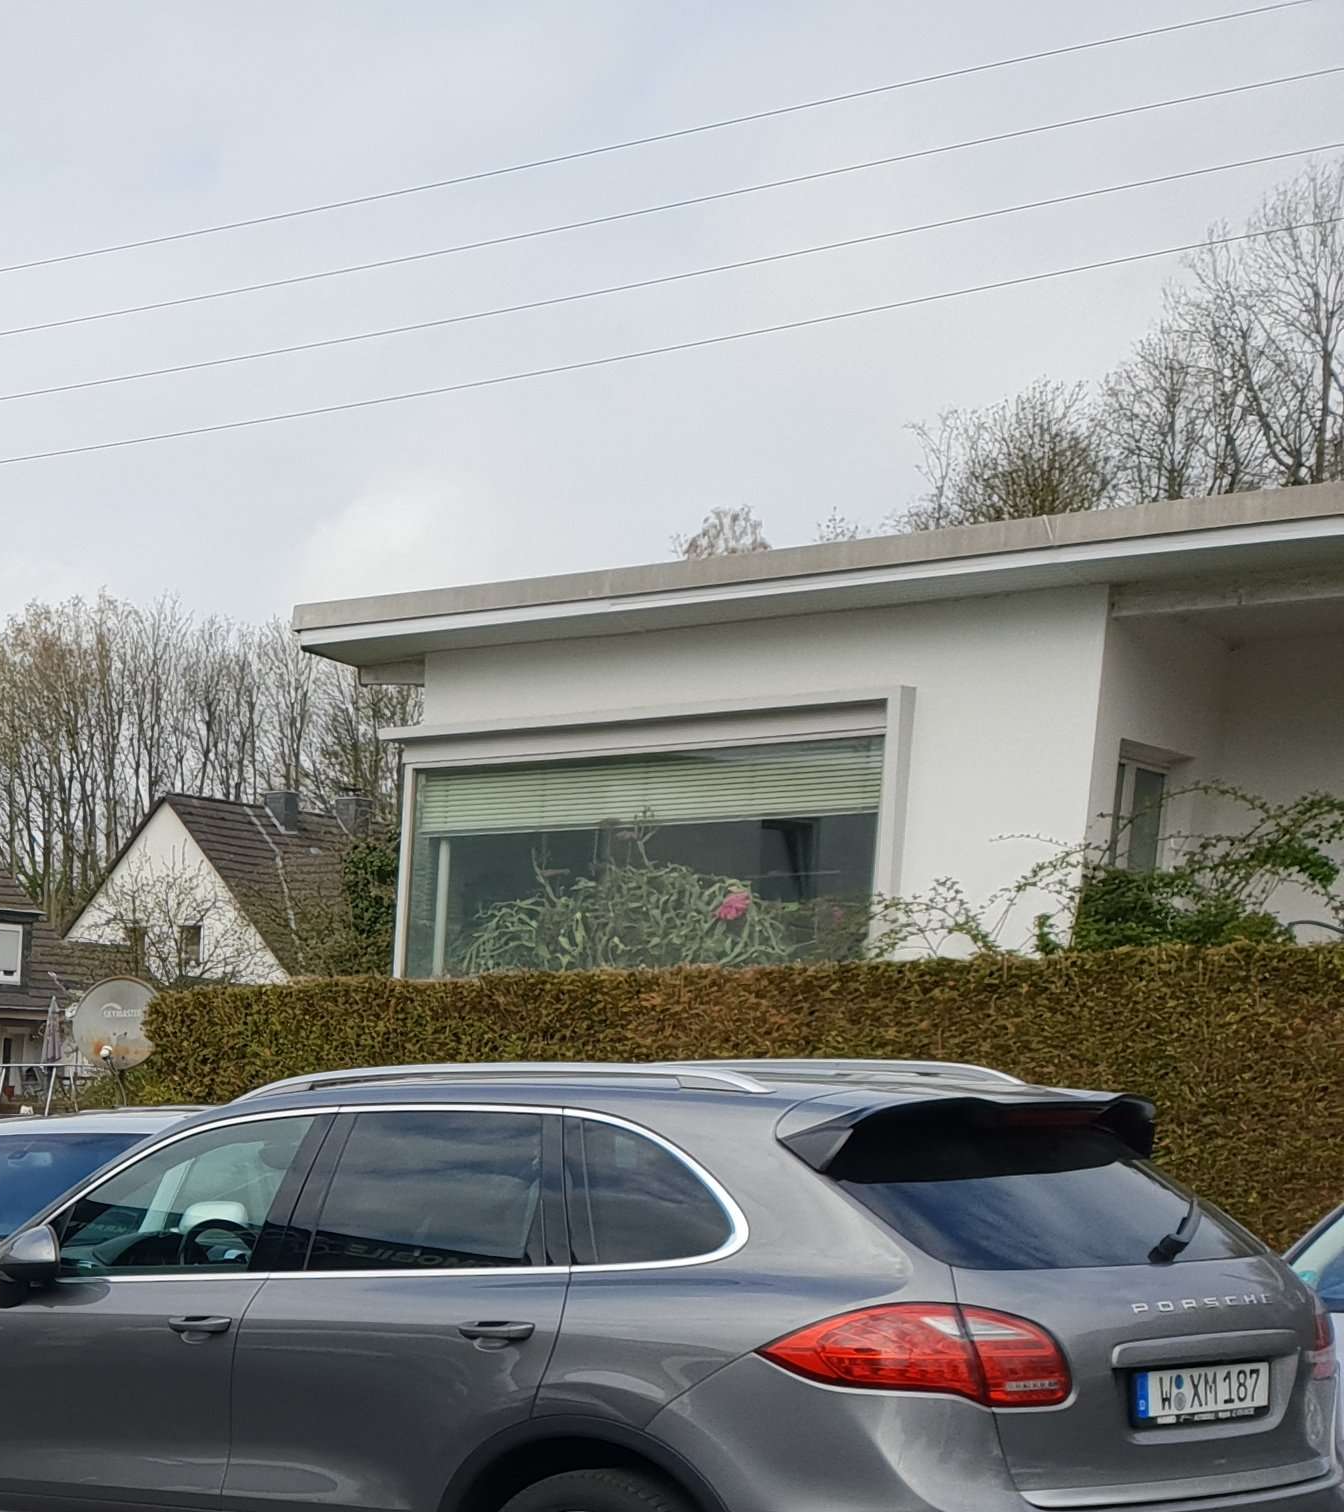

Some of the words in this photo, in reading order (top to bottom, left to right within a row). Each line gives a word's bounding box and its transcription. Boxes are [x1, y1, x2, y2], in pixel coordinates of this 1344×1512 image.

[1131, 1293, 1273, 1315] PORSCHE
[1159, 1376, 1173, 1411] W
[1190, 1371, 1218, 1409] XM
[1223, 1368, 1261, 1404] 187
